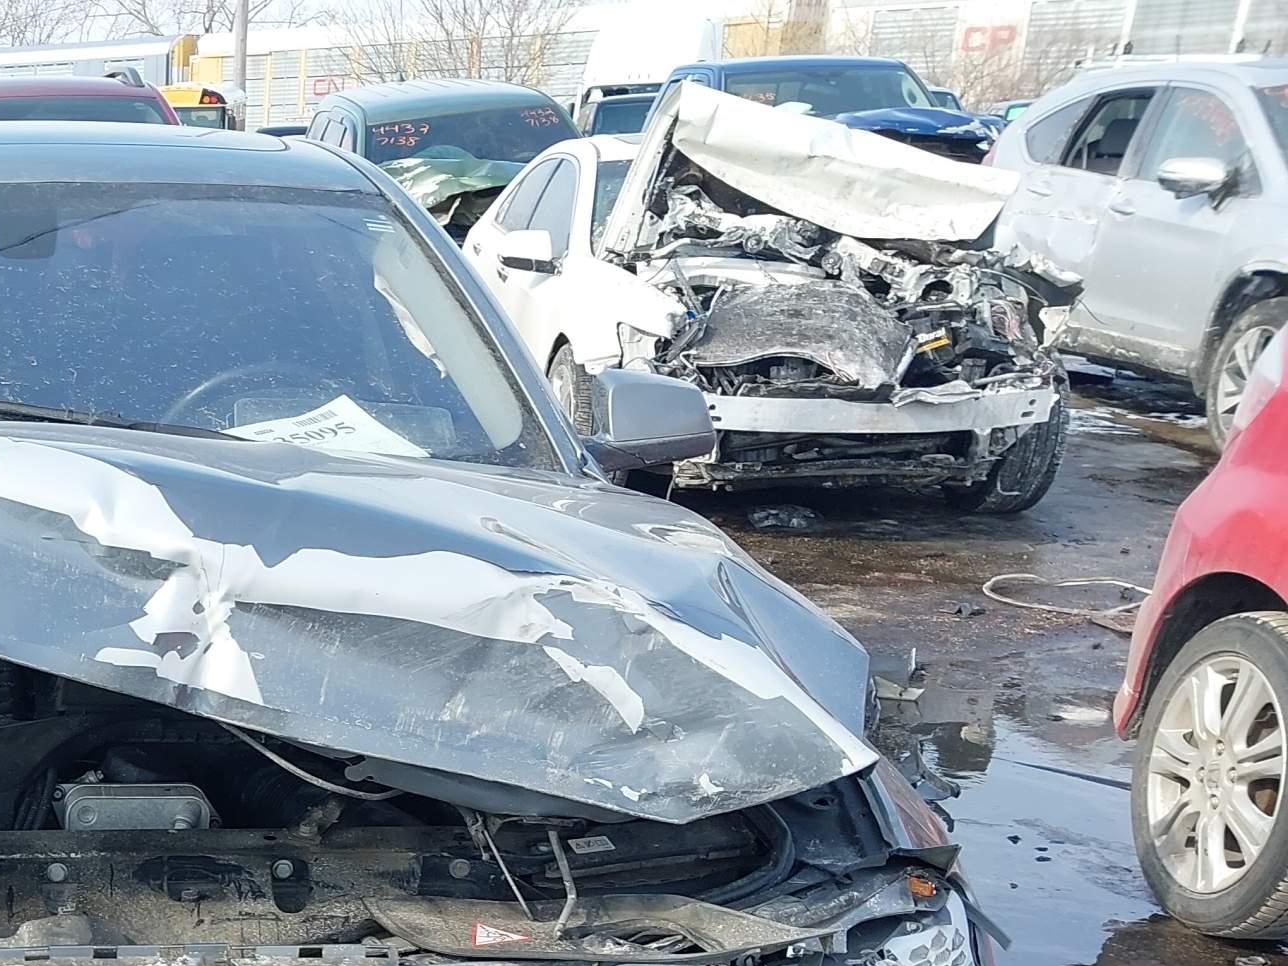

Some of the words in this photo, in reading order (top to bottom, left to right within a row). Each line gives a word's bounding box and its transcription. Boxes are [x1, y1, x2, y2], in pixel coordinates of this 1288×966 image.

[962, 26, 1016, 57] CP
[313, 76, 345, 96] CN
[376, 136, 421, 147] 7138
